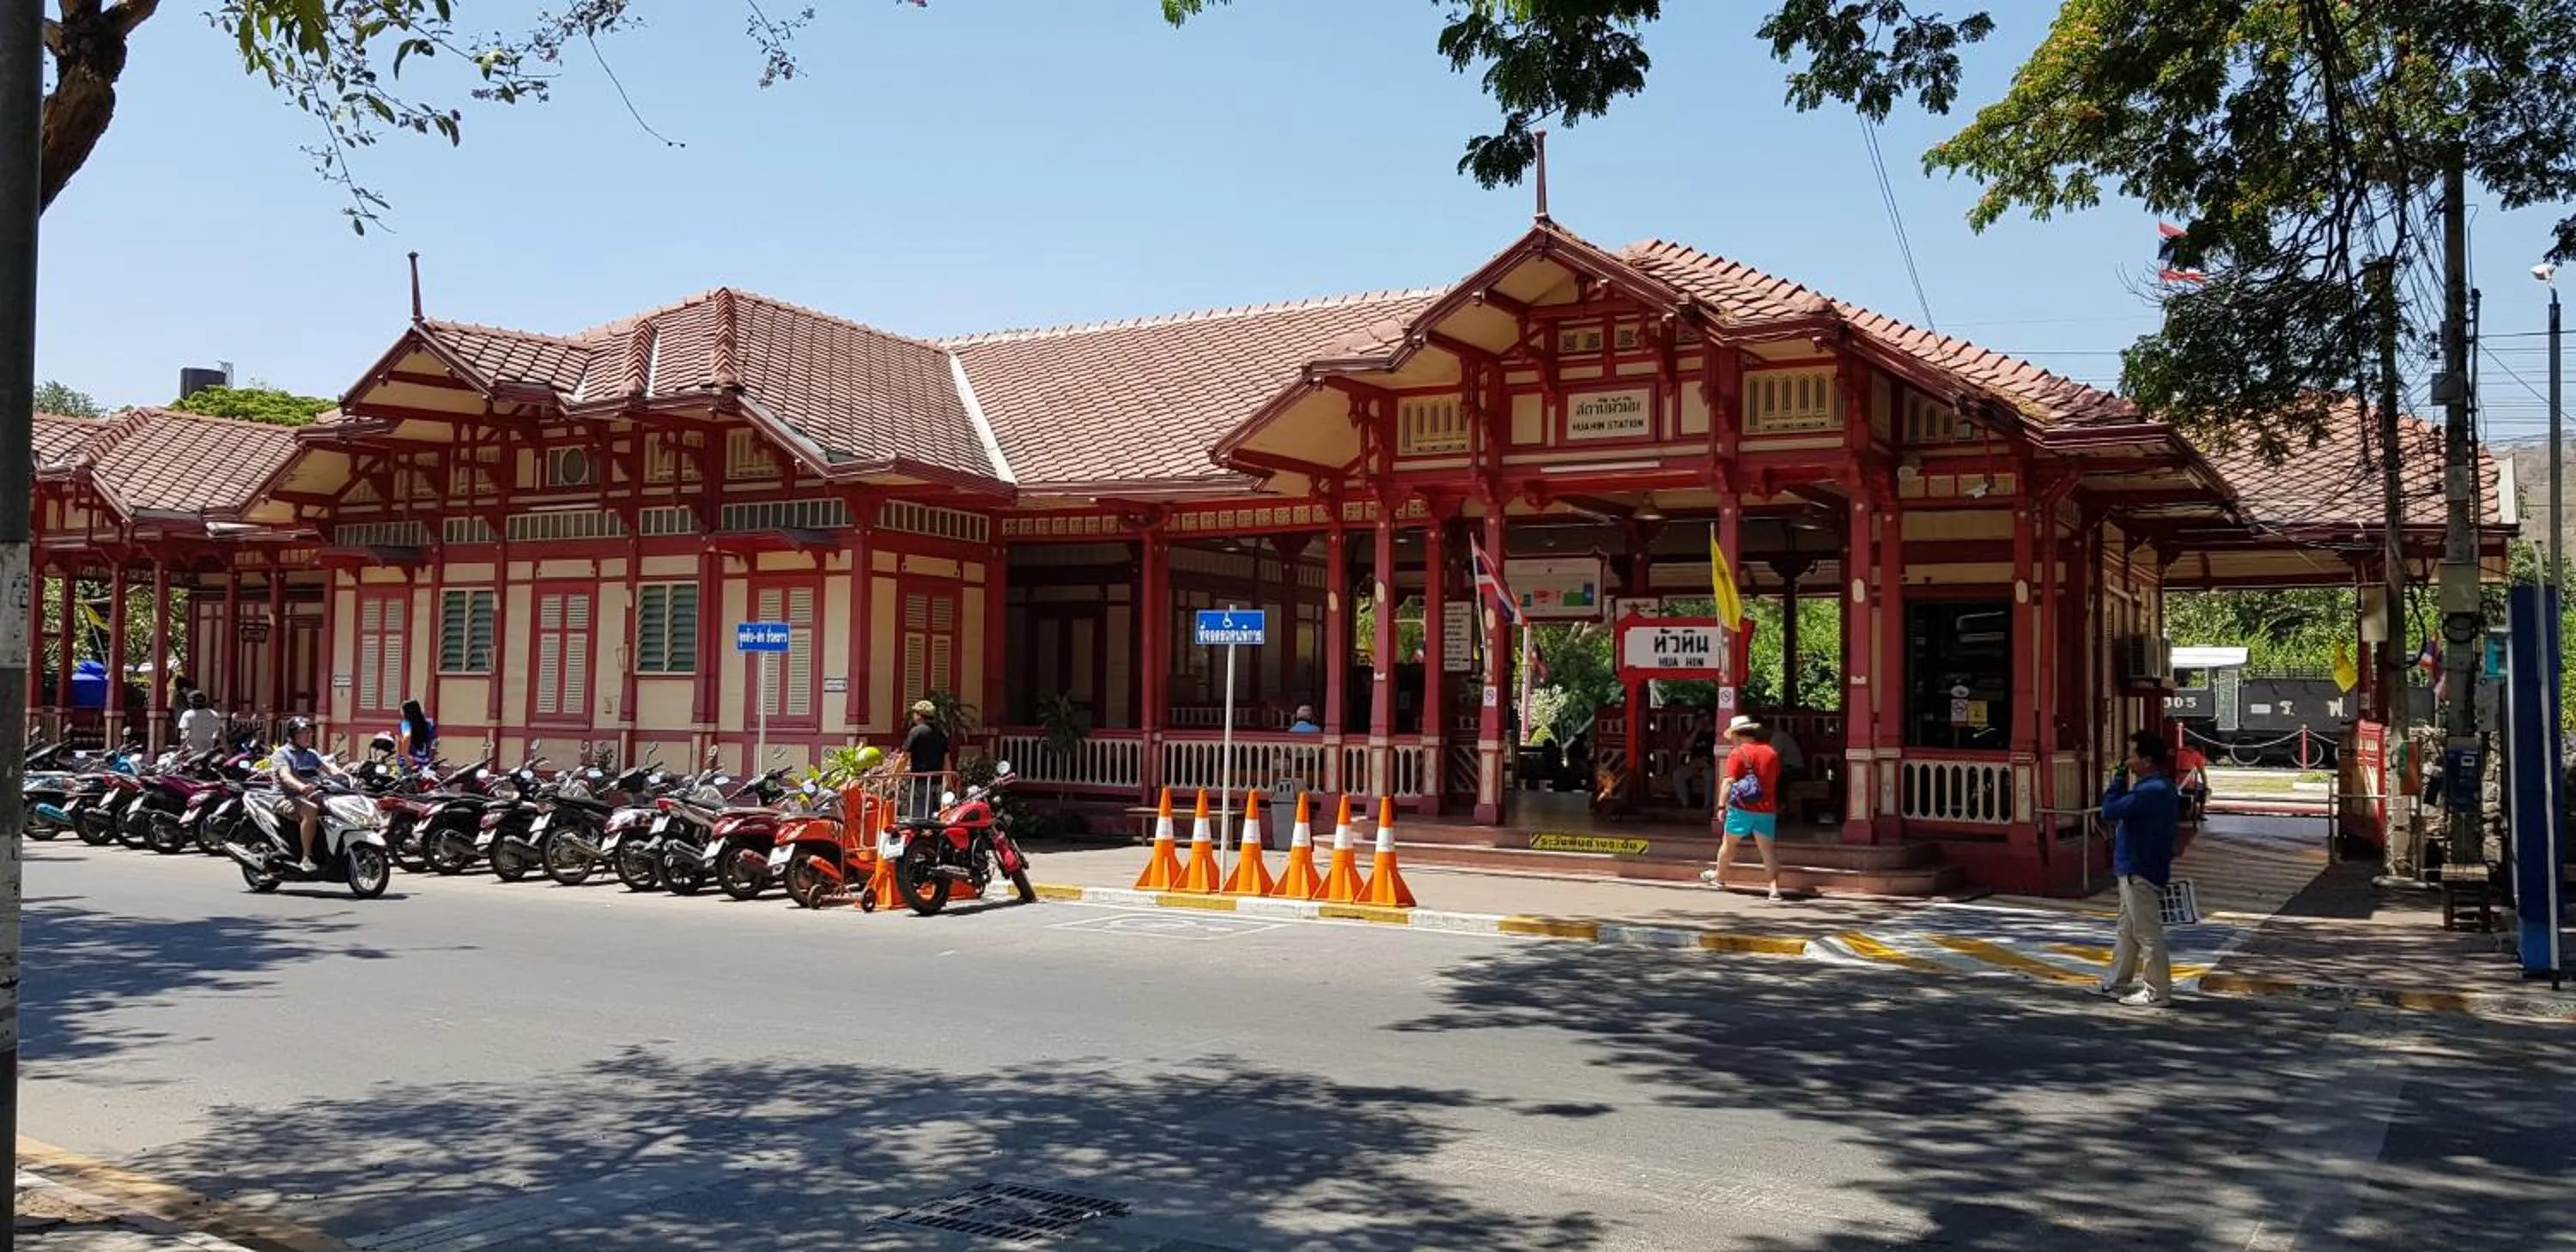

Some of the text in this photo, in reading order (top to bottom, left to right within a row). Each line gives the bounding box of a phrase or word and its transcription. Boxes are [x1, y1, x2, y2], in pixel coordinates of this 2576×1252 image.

[1572, 418, 1643, 431] HUA HIN STATION
[1654, 628, 1709, 653] หัวหิน
[1659, 657, 1704, 666] HUA HIN
